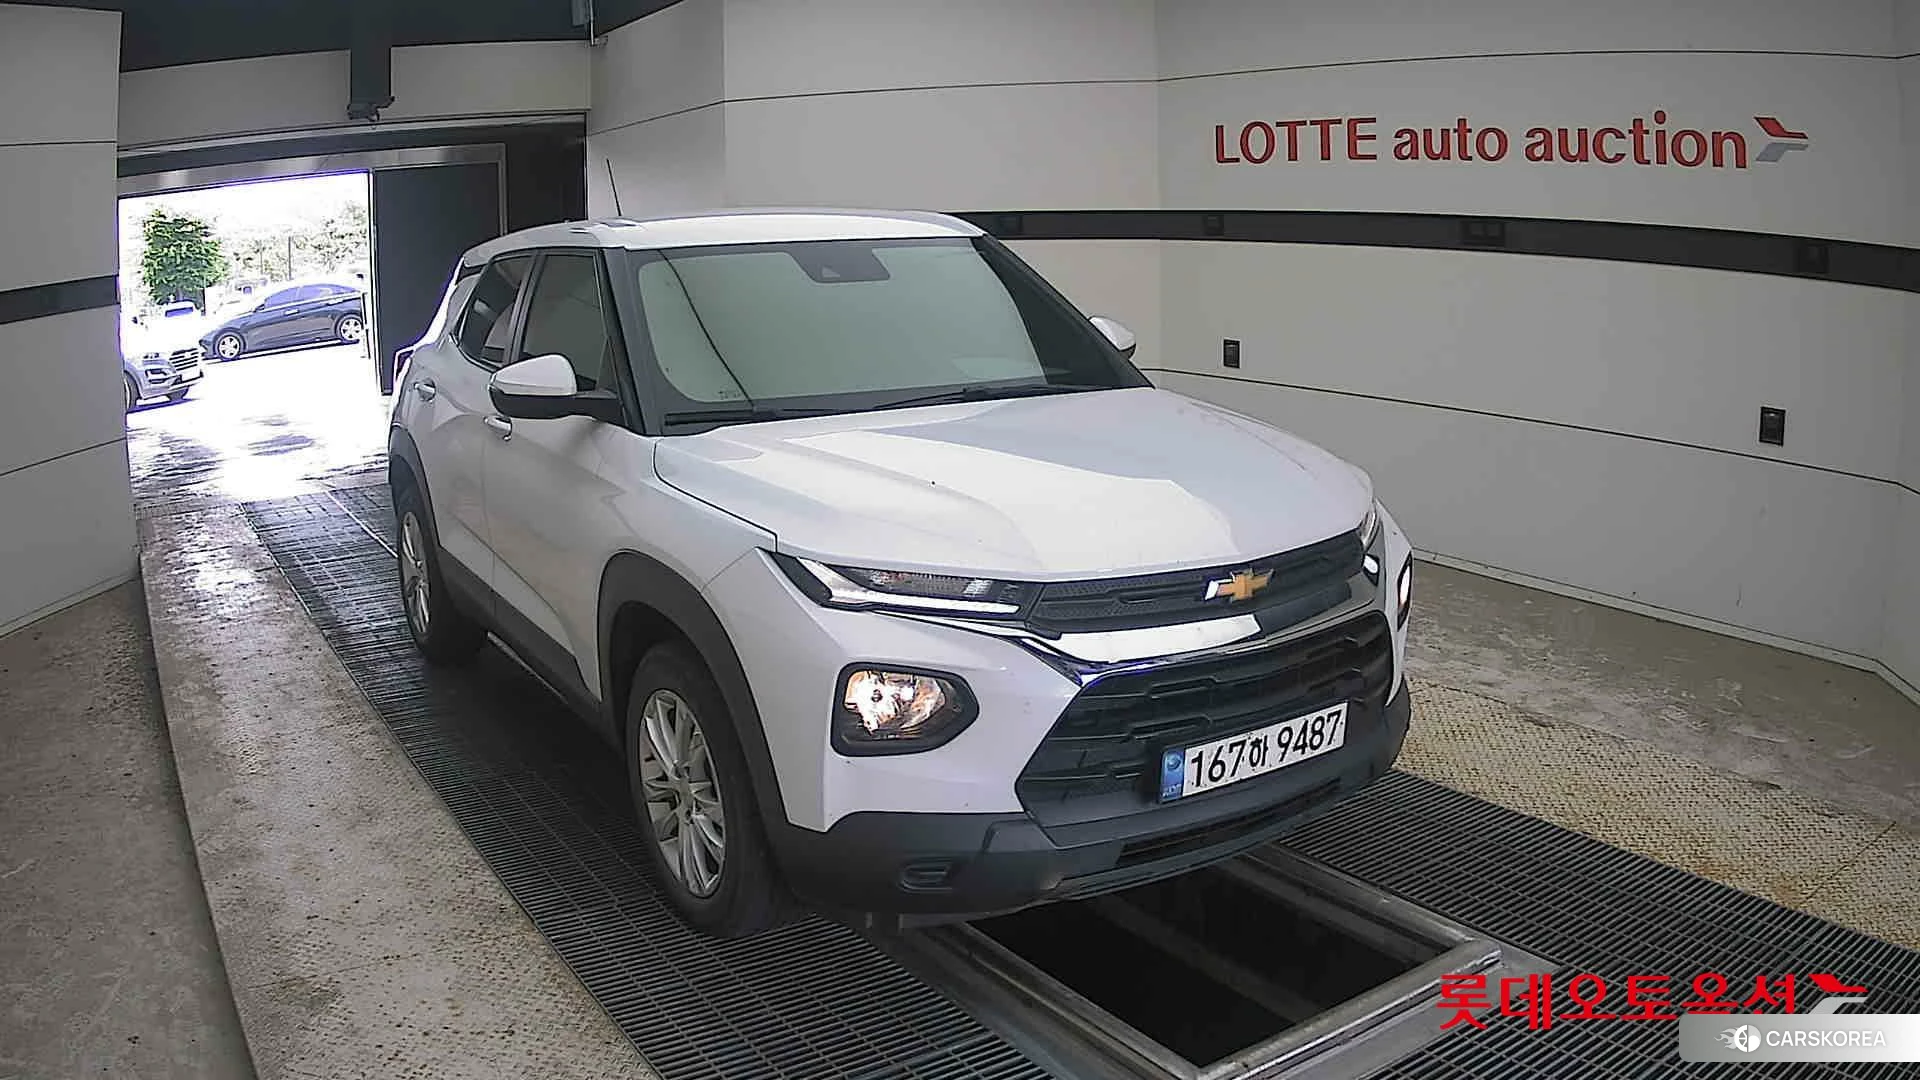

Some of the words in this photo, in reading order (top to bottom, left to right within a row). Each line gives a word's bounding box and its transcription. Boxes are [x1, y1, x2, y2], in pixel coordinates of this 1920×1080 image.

[1214, 116, 1378, 165] LOTTE
[1392, 116, 1510, 163] auto
[1523, 109, 1748, 169] auction
[1191, 735, 1269, 788] 167하
[1276, 709, 1343, 763] 9487
